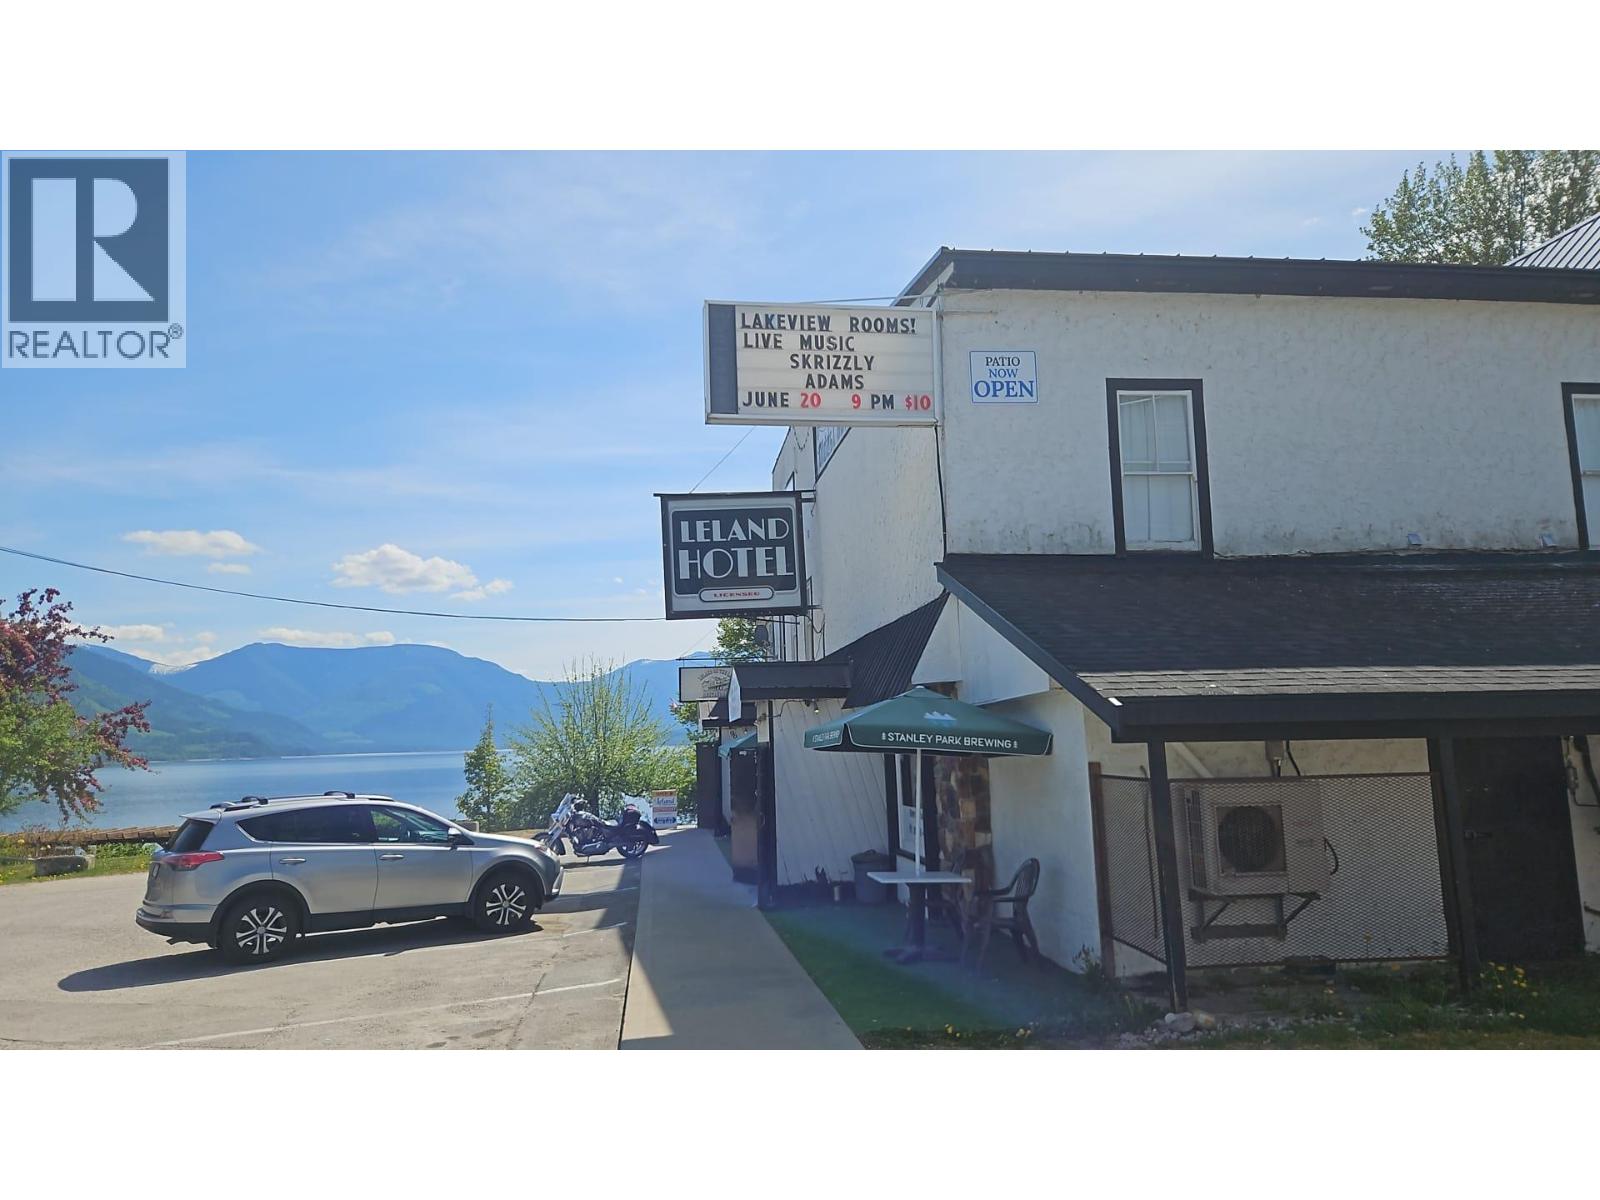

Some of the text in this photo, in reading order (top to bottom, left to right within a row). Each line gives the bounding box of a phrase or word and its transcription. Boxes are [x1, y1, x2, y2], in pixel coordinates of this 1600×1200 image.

[741, 313, 917, 334] LAKEVIEW ROOMS!
[743, 333, 855, 351] LIVE MUSIC
[790, 353, 875, 371] SKRIZZLY
[985, 356, 1021, 367] PATIO
[805, 373, 865, 390] ADAMS
[988, 368, 1018, 378] NOW
[973, 380, 1035, 398] OPEN
[742, 392, 932, 411] JUNE 20 9 PM $10
[680, 518, 790, 543] LELAND
[678, 546, 795, 580] HOTEL
[887, 732, 1012, 749] STANLEY PARK BREWING
